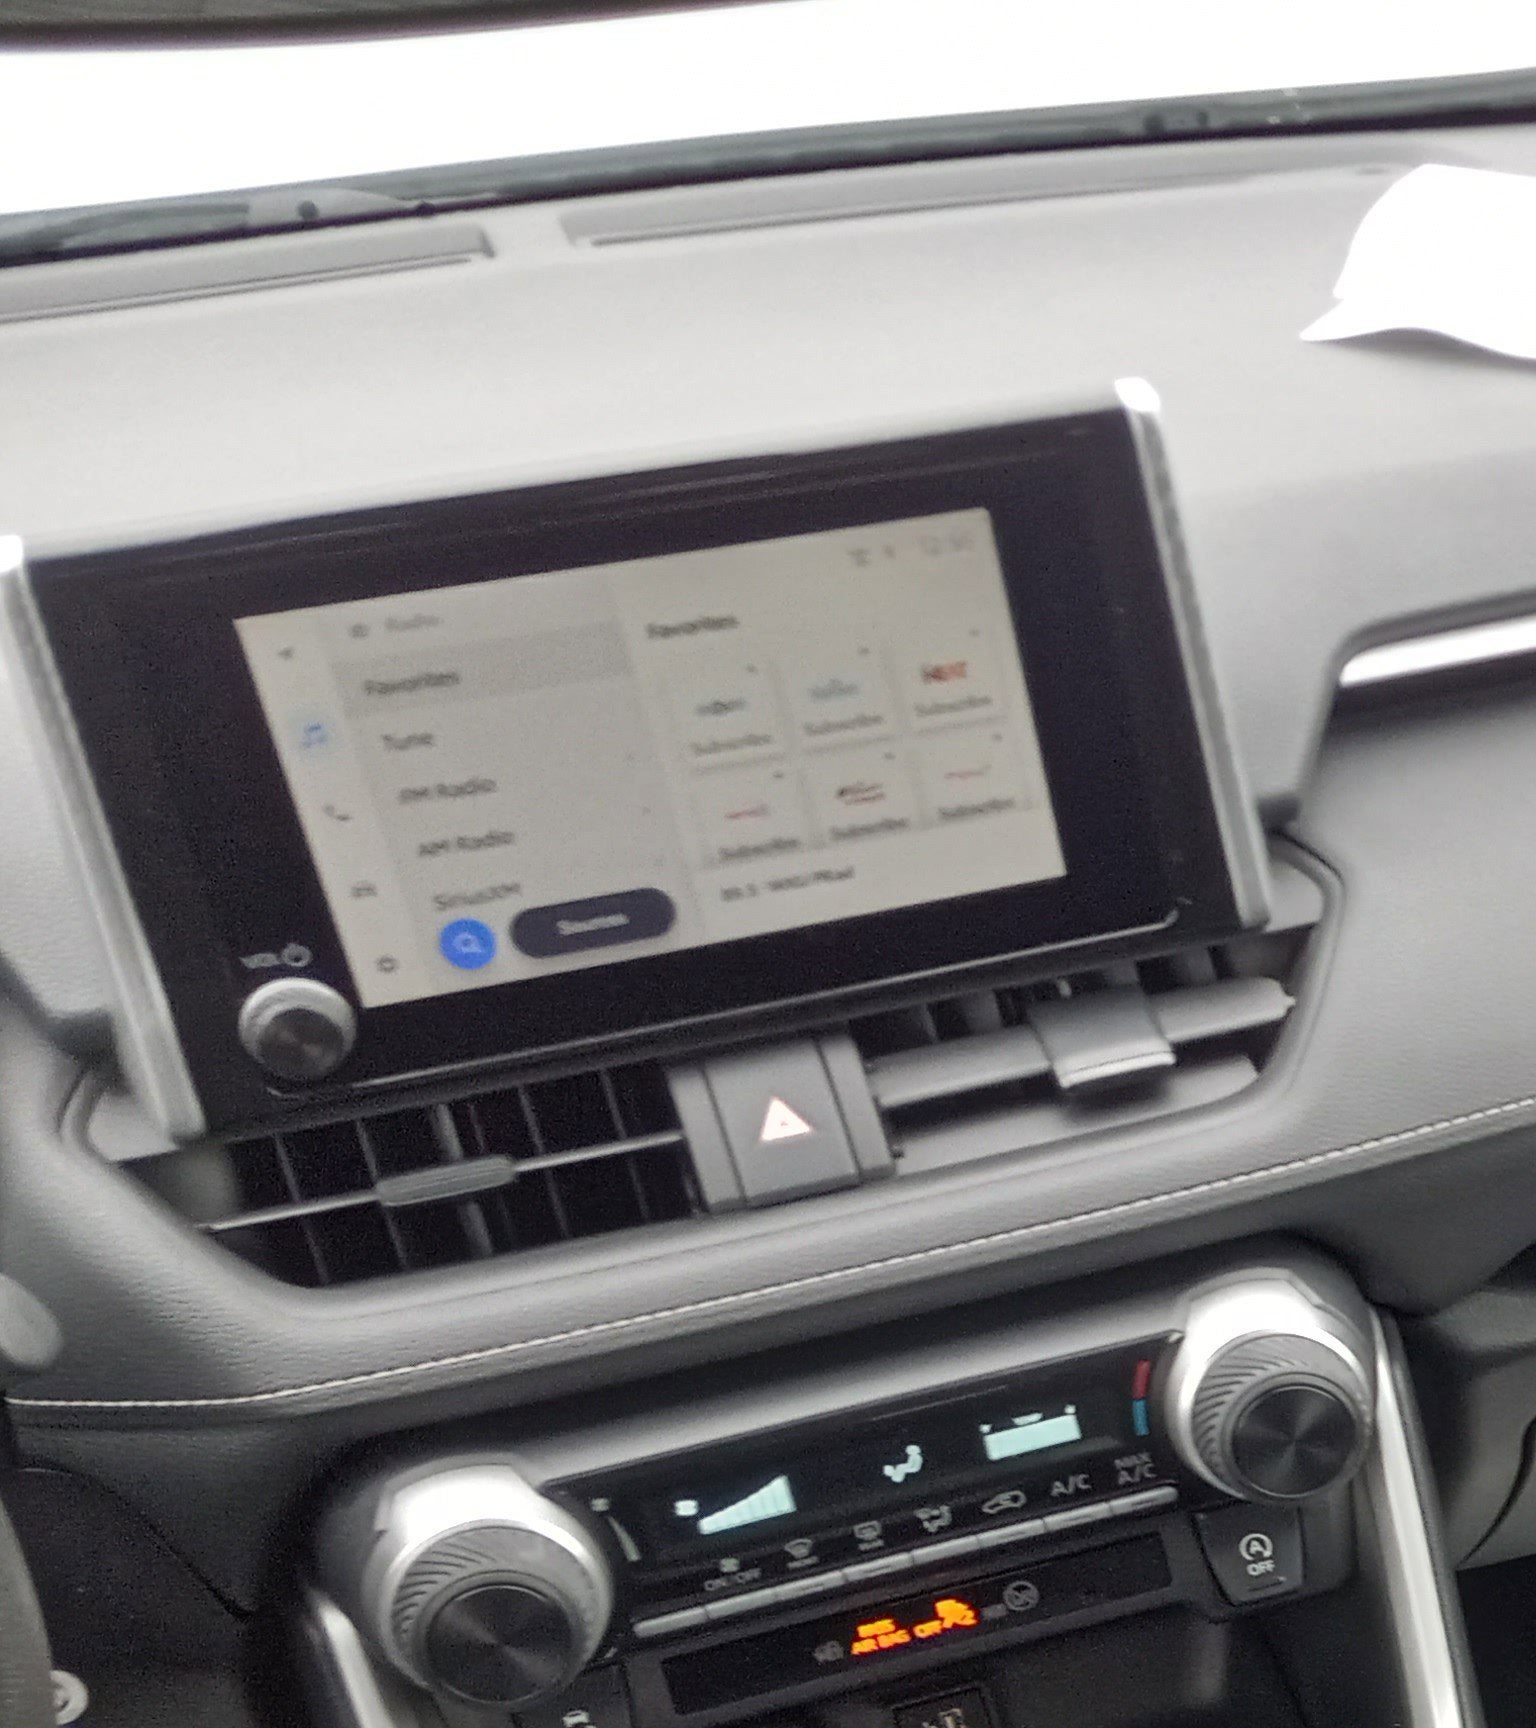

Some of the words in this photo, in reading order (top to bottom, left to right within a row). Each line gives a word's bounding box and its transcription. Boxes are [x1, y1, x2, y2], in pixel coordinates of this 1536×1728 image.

[363, 670, 461, 696] Favorites
[1050, 1474, 1091, 1497] A/C
[1118, 1463, 1157, 1485] A/C
[1246, 1560, 1277, 1576] OFF
